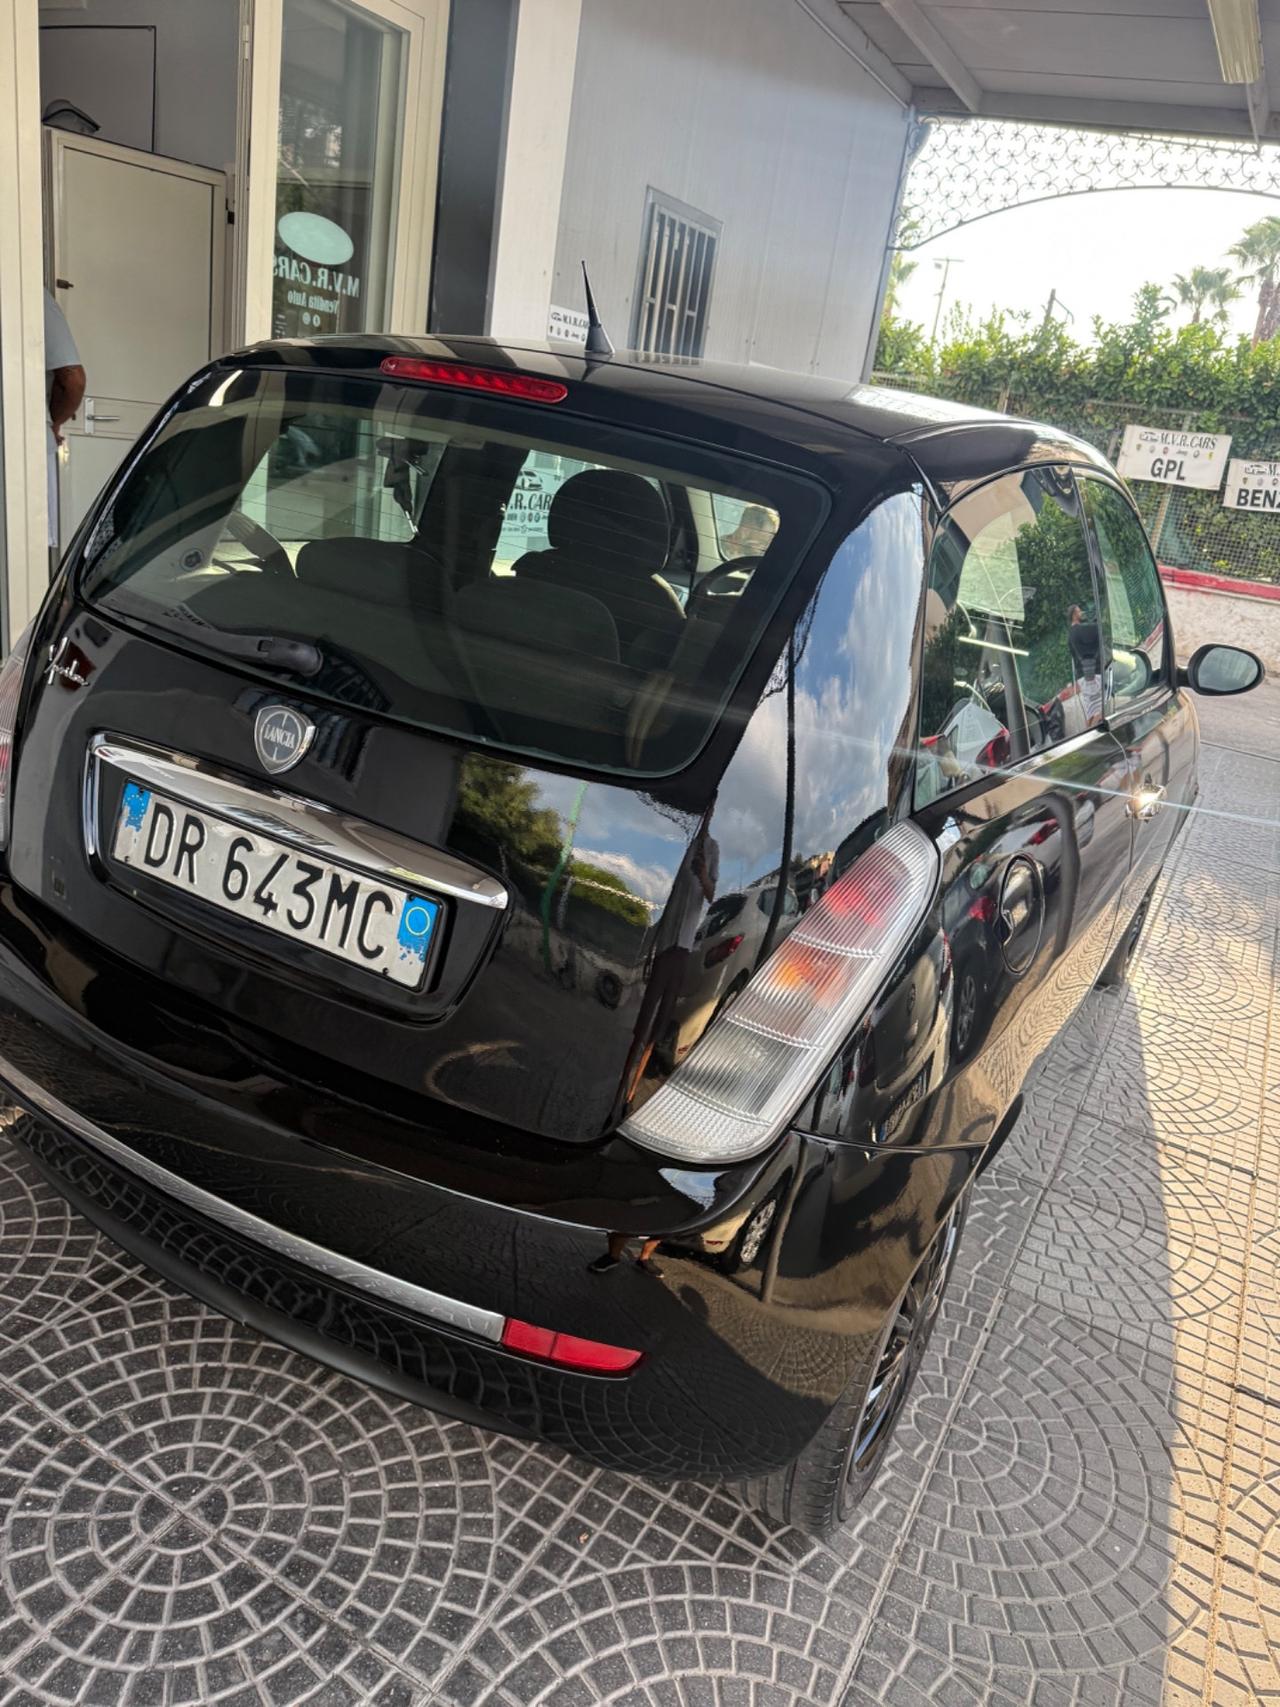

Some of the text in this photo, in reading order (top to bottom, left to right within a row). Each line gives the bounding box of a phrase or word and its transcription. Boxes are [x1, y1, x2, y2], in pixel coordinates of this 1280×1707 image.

[1150, 458, 1186, 481] GPL
[264, 724, 295, 749] LANCIA
[144, 802, 394, 960] DR 643MC
